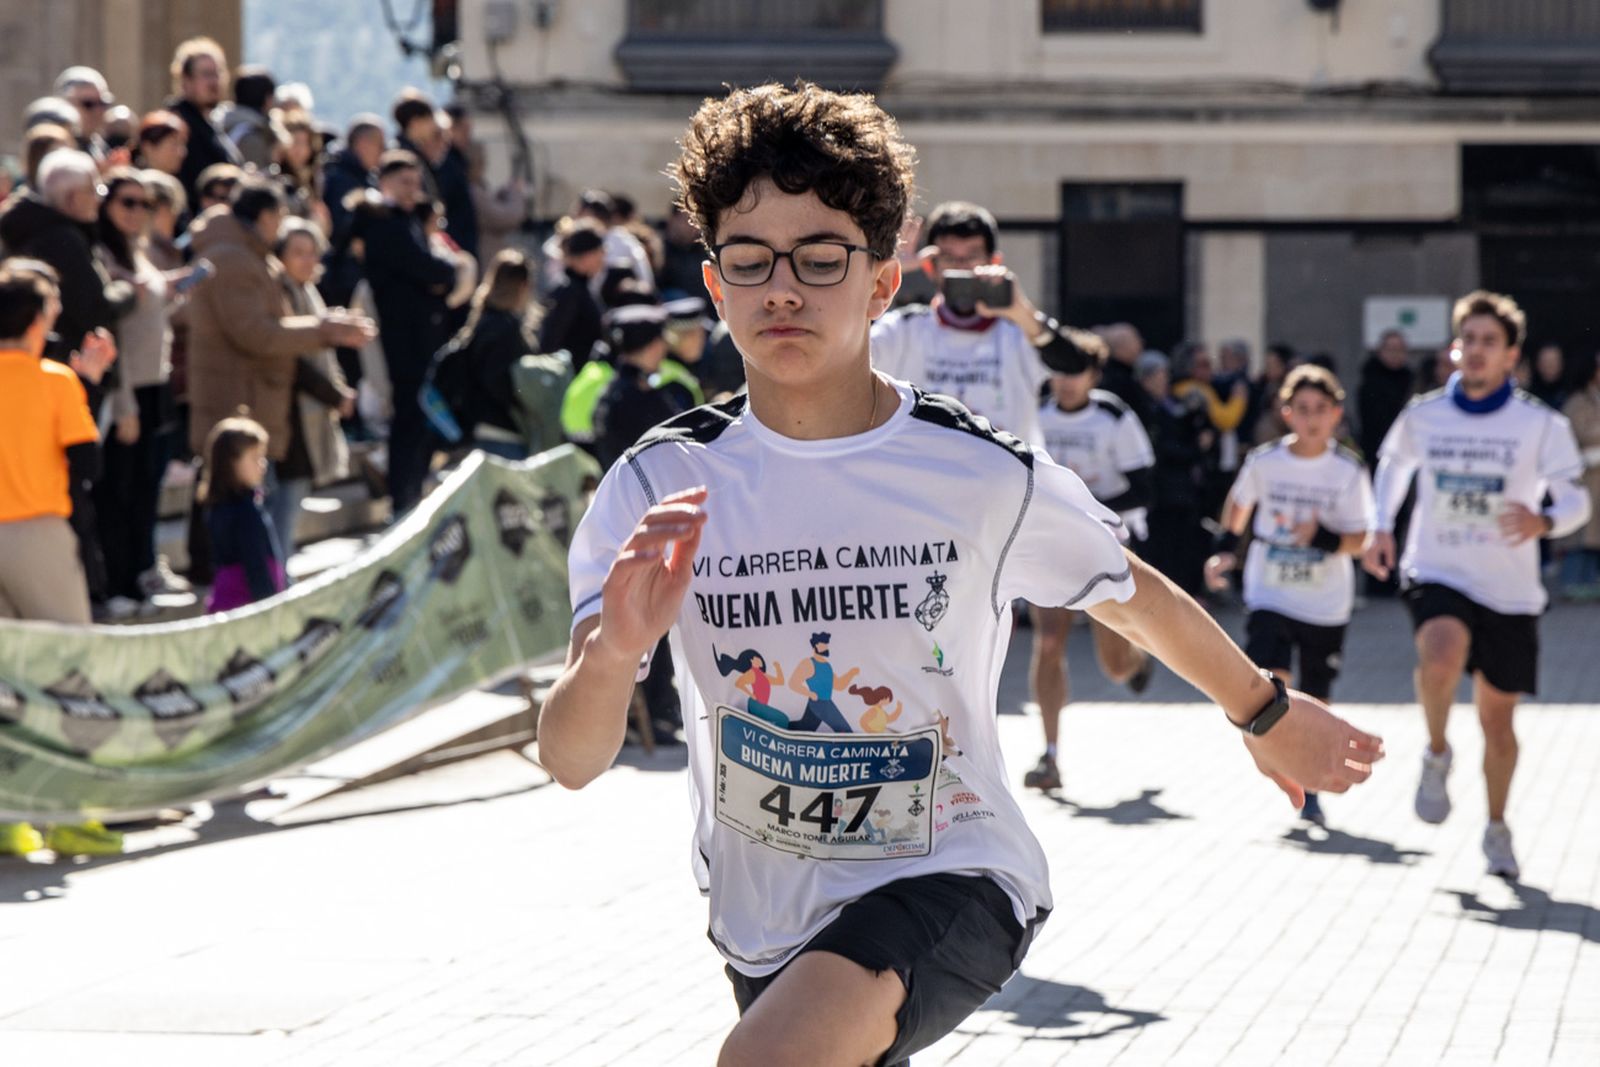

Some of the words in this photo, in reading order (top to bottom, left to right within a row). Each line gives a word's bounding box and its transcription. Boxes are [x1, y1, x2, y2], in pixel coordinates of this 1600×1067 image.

[692, 557, 710, 577] VI
[718, 547, 829, 577] CARRERA
[836, 540, 959, 568] CAMINATA
[695, 591, 783, 629] BUENA
[791, 583, 910, 623] MUERTE
[742, 727, 756, 742] VI
[759, 732, 826, 760] CARRERA
[830, 745, 909, 759] CAMINATA
[741, 744, 793, 780] BUENA
[799, 762, 871, 784] MUERTE
[759, 784, 883, 834] 447
[767, 823, 801, 839] MARCO
[830, 834, 872, 844] AGUILAR
